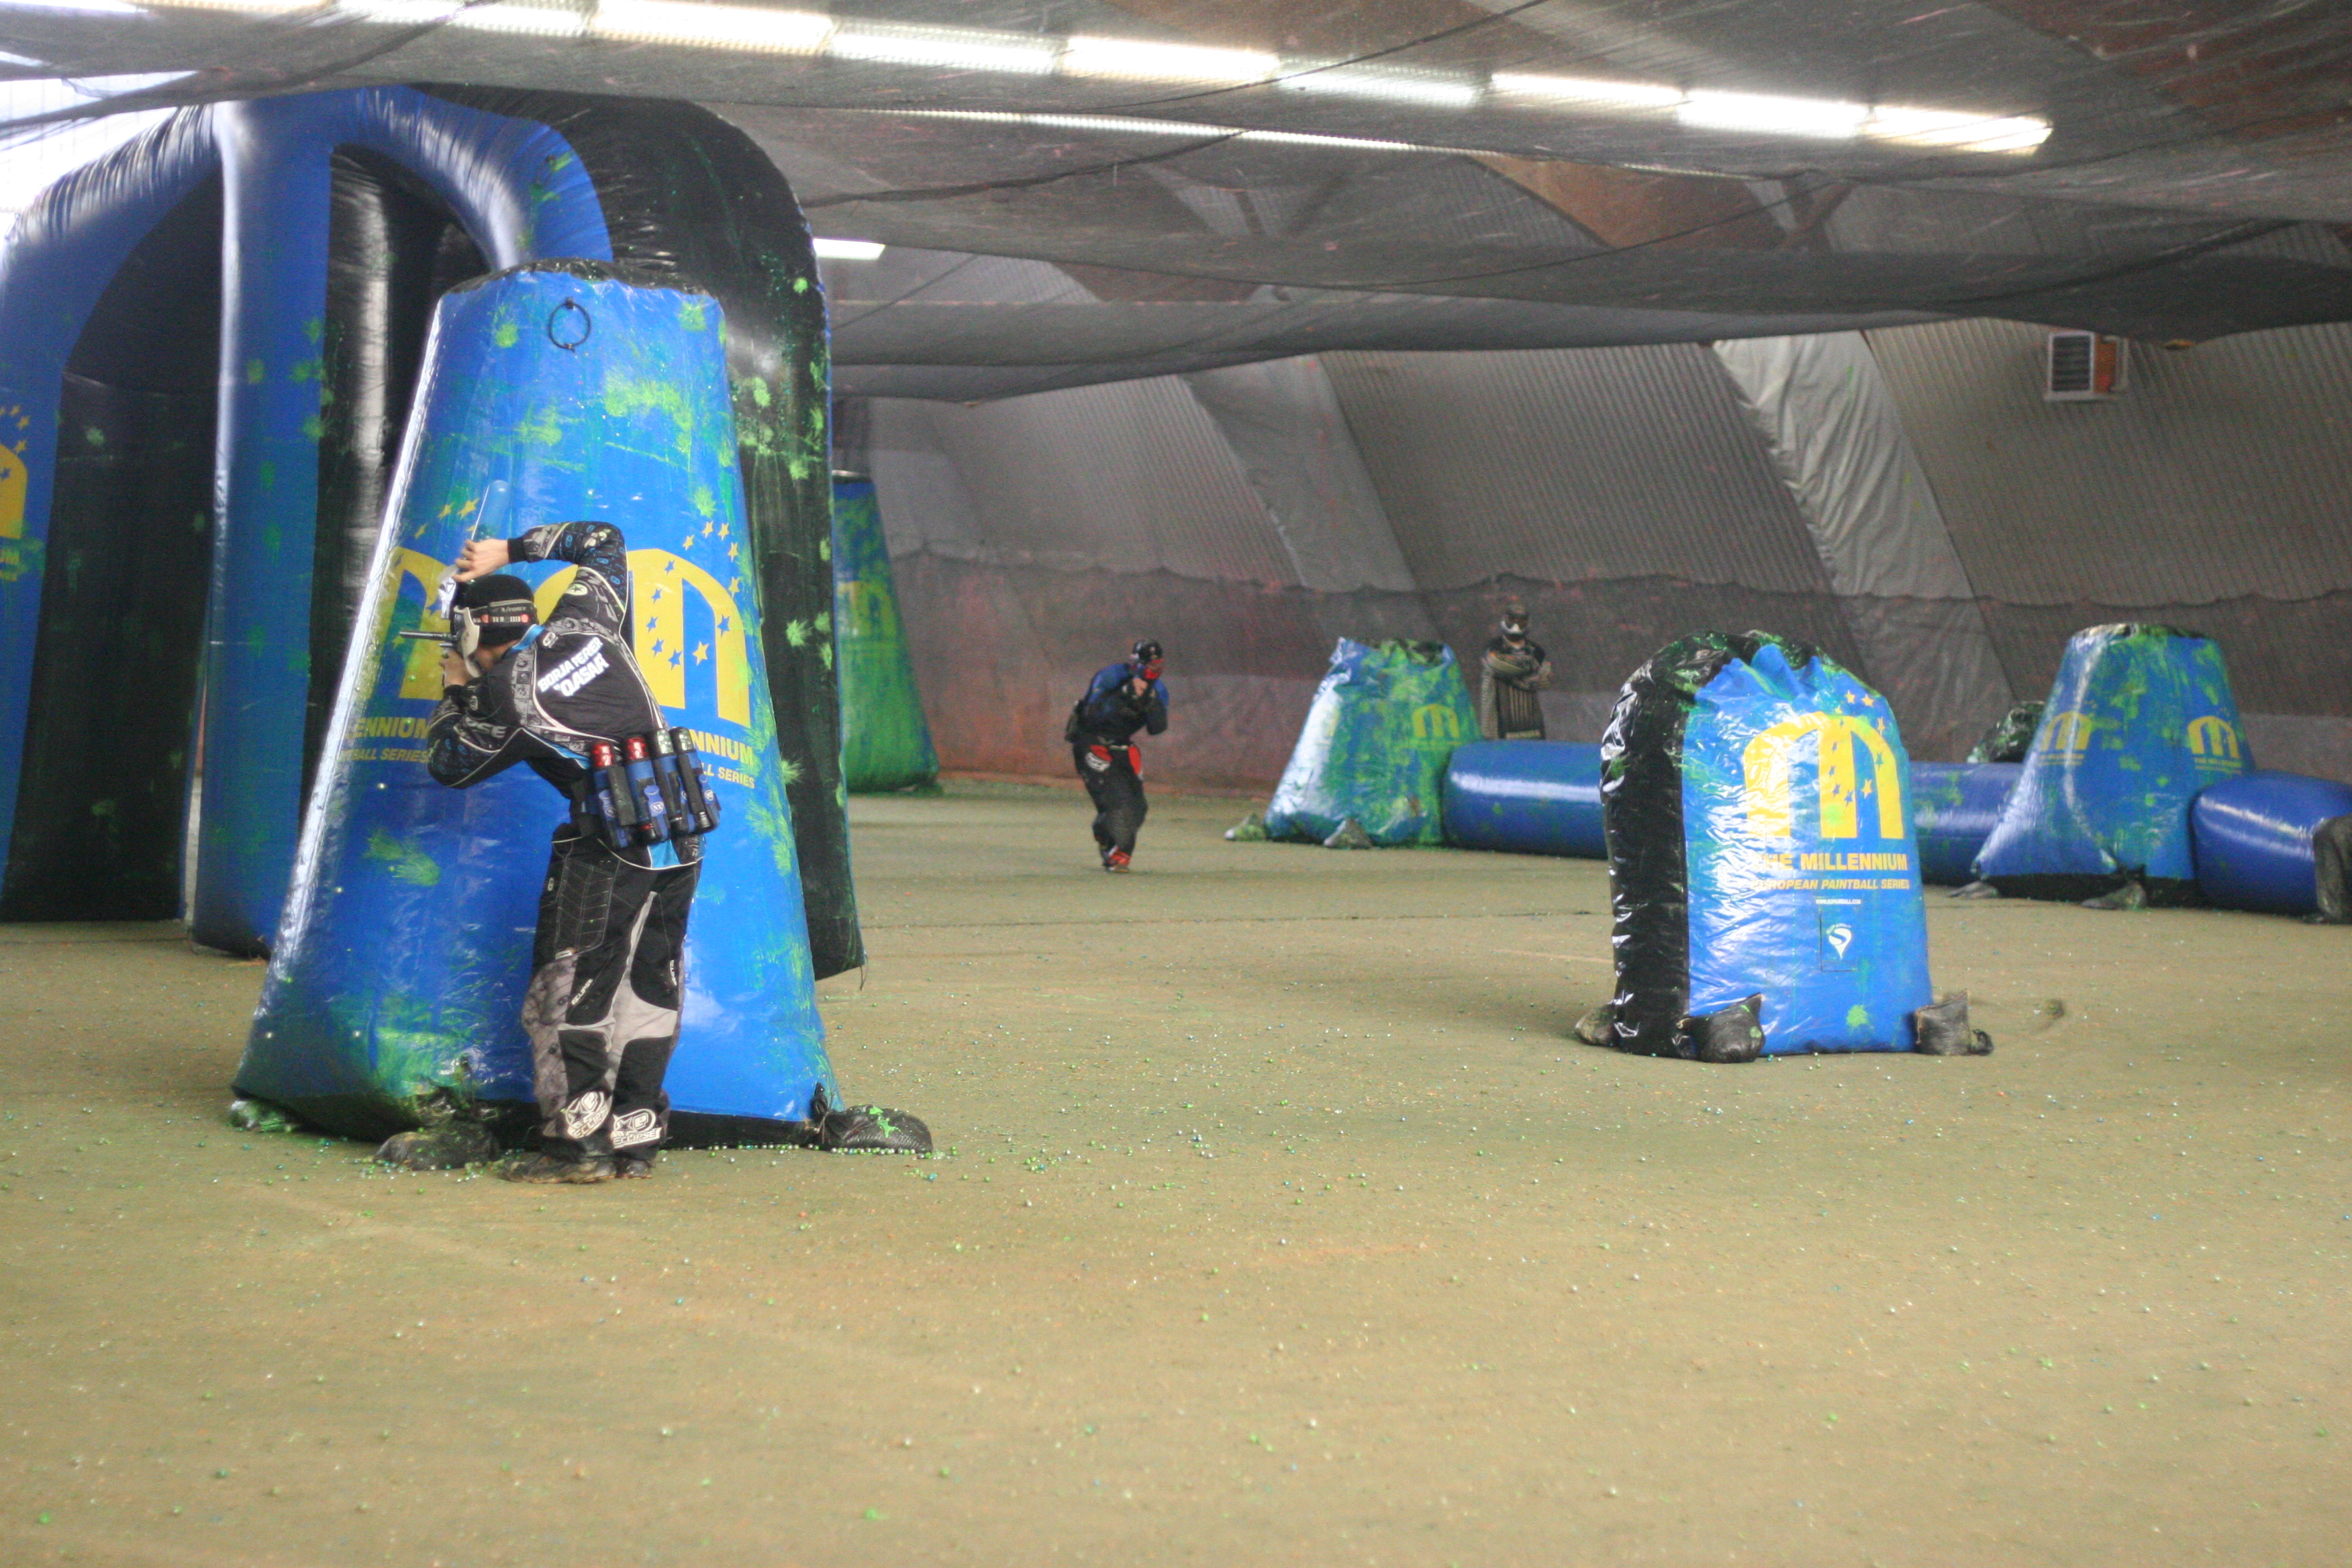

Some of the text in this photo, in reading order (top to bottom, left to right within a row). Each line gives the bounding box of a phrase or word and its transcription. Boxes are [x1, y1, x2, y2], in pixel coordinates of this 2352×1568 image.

[538, 659, 576, 693] BORJA
[689, 728, 754, 767] NNIUM
[717, 766, 756, 789] SERIES
[1800, 852, 1909, 871] MILLENNIUM
[1820, 879, 1879, 890] PAINTBALL
[1880, 879, 1911, 890] SERIES
[571, 1106, 609, 1138] ECLIPS
